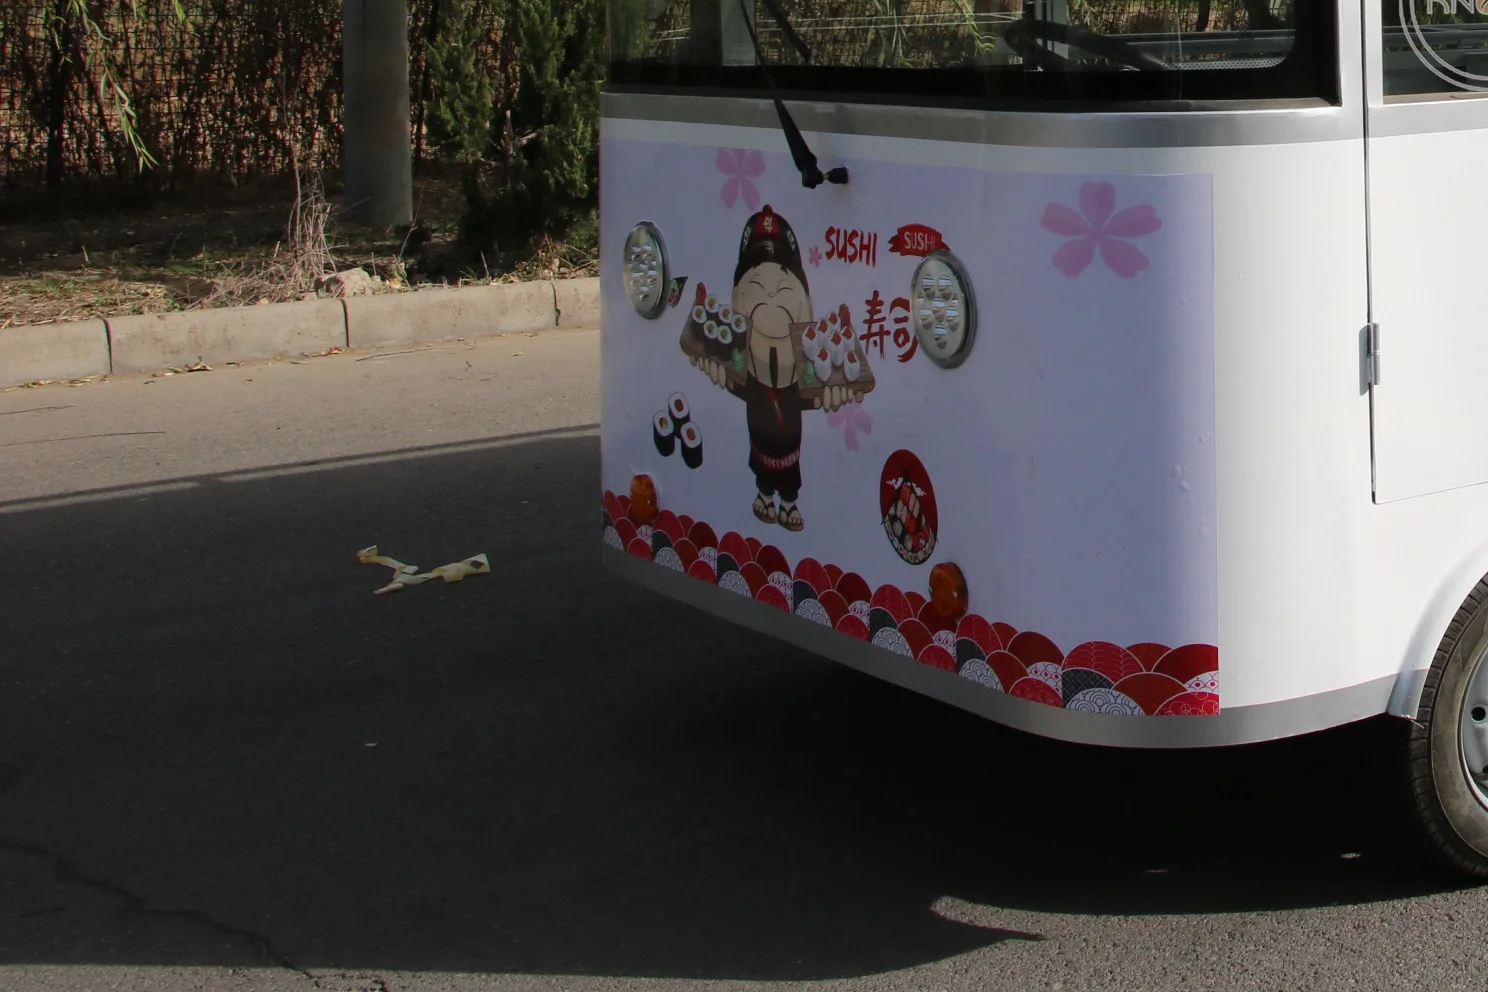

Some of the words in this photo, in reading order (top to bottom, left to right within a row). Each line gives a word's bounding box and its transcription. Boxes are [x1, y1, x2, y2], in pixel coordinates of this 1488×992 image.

[825, 226, 877, 267] SUSHI
[904, 230, 936, 251] SUSHI
[859, 289, 918, 363] 寿司
